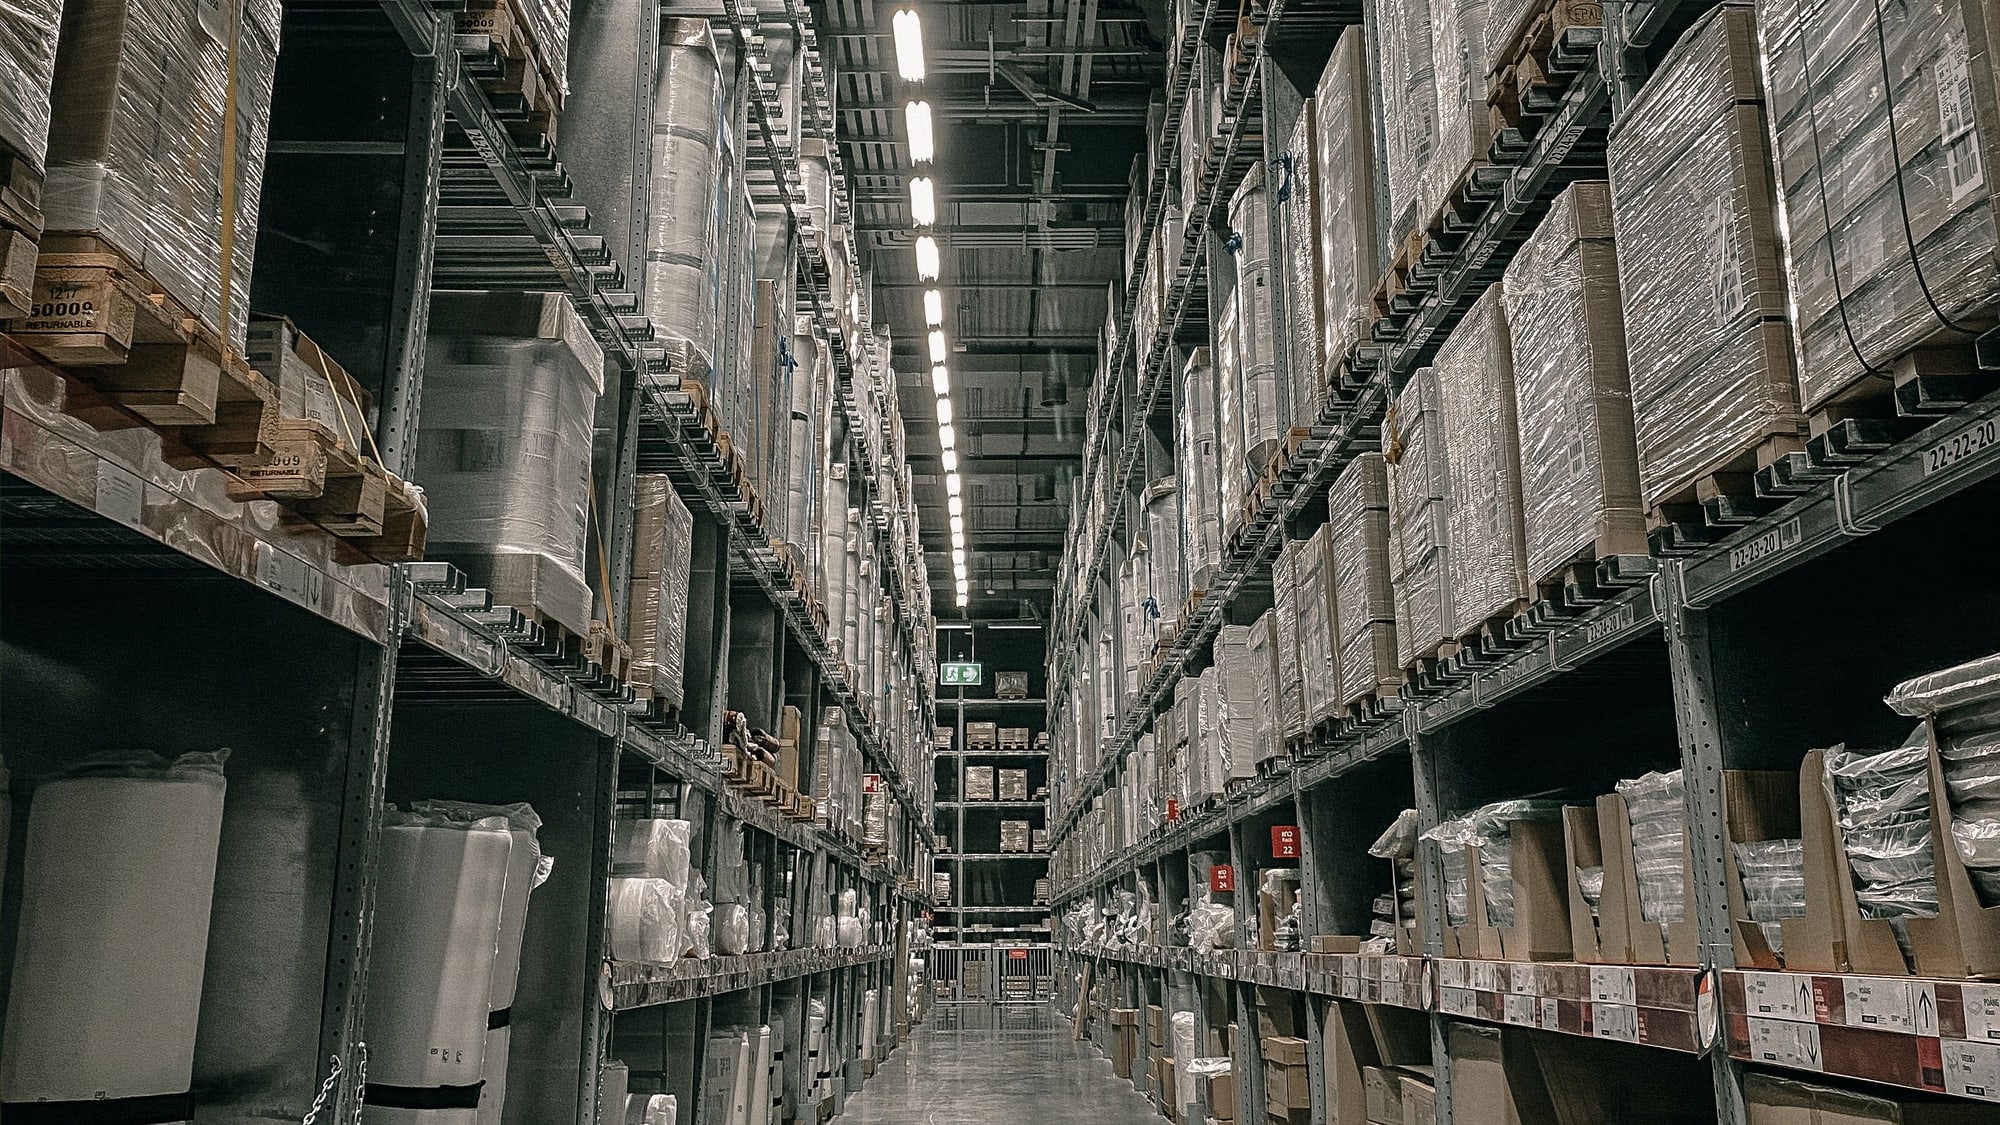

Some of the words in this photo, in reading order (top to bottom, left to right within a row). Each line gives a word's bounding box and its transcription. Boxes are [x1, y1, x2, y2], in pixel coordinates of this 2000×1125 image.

[1574, 8, 1602, 20] EPAL
[30, 301, 94, 318] 50009
[25, 320, 94, 330] RETURNABLE
[1930, 420, 1996, 472] 22-22-20
[250, 468, 301, 477] RETURNABLE
[1734, 533, 1775, 570] 22-23-20
[1283, 845, 1294, 855] 22
[1219, 881, 1227, 889] 24
